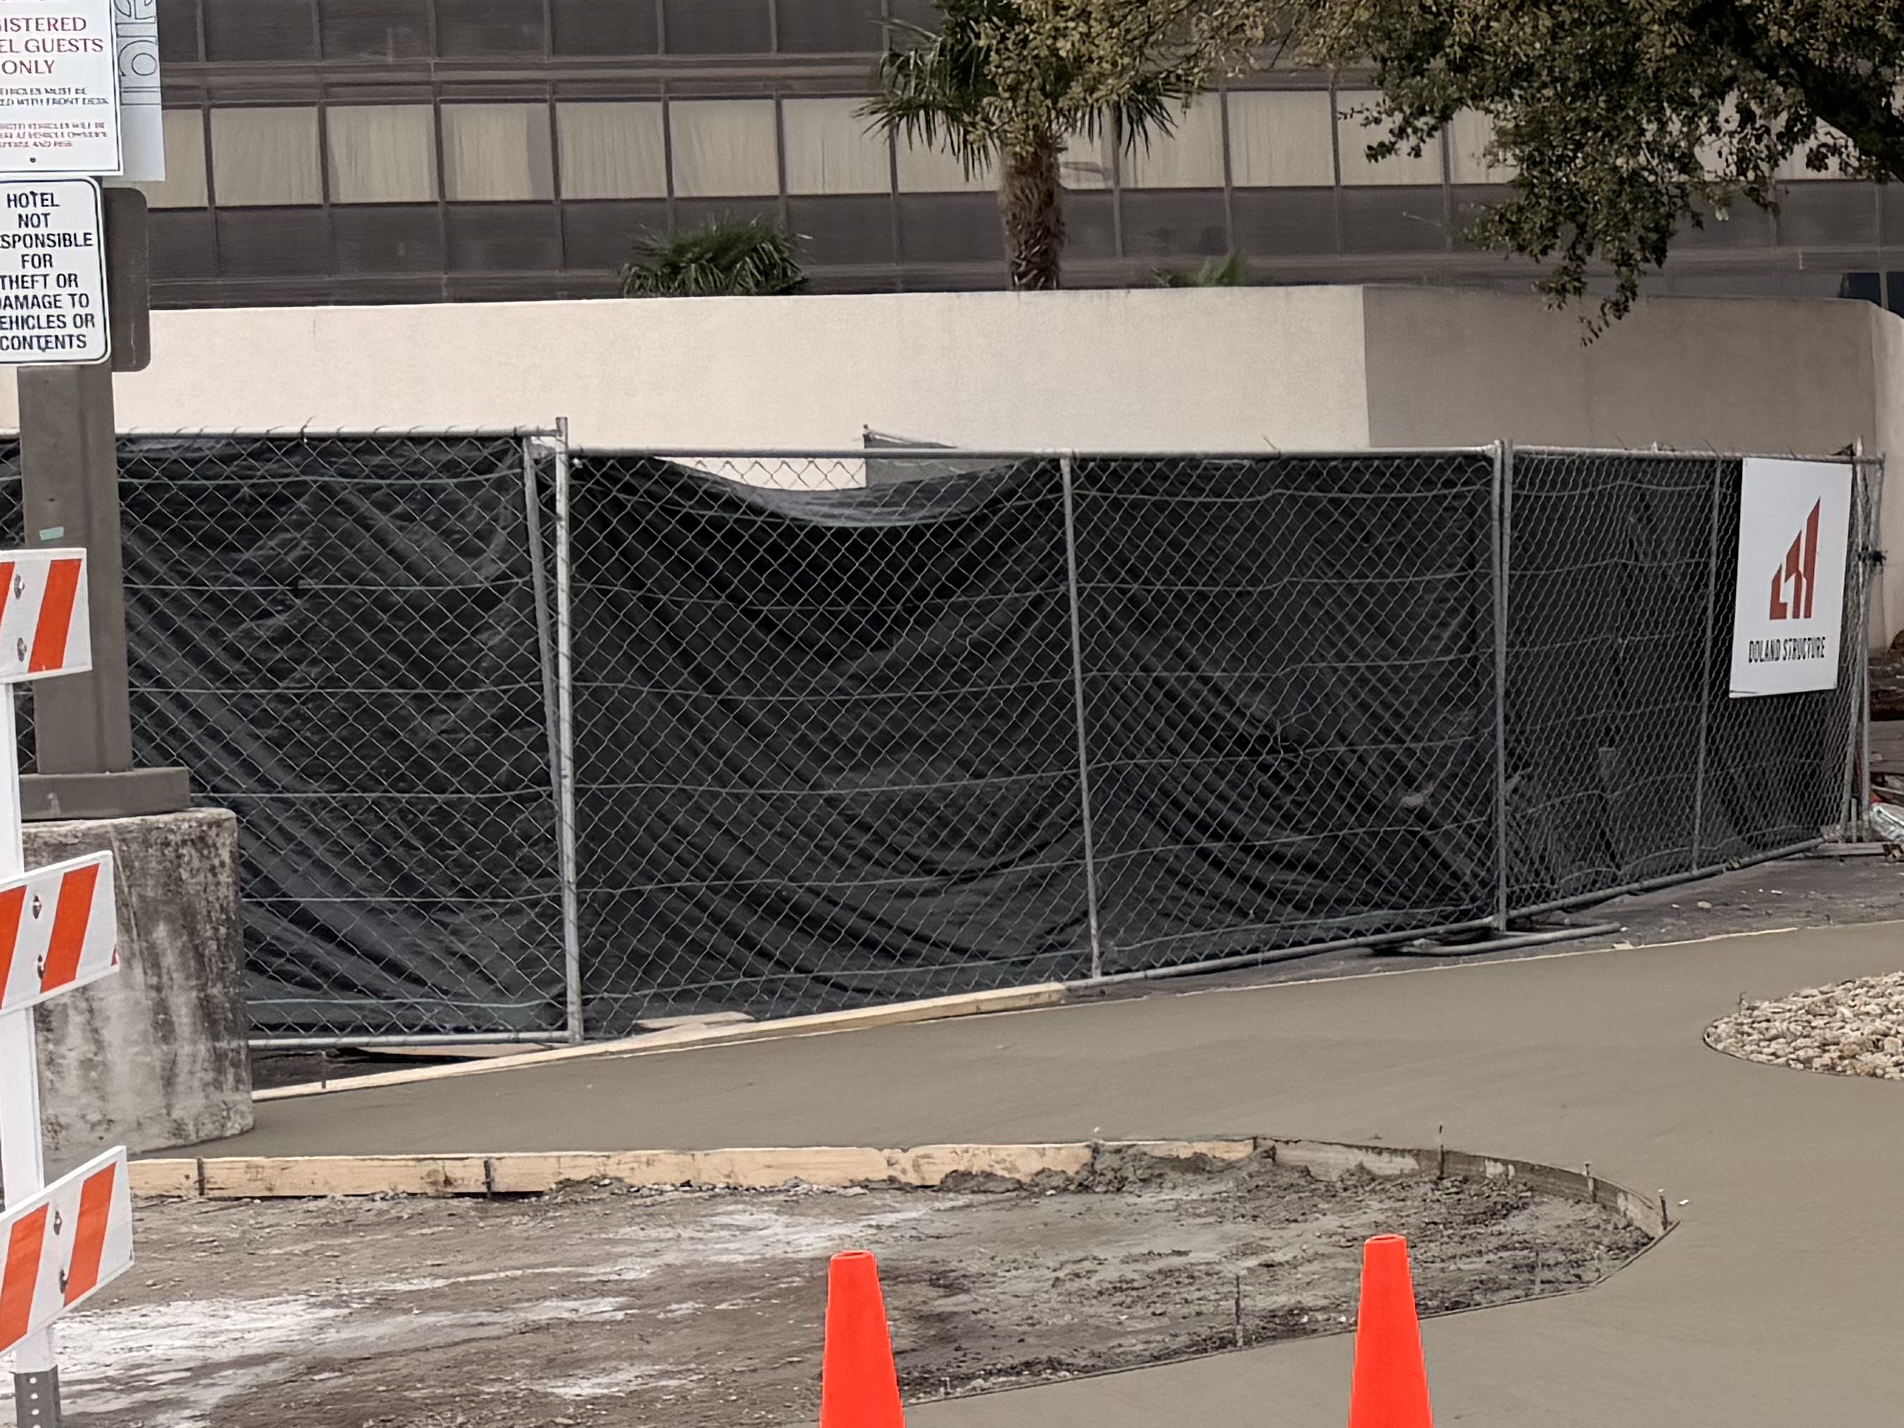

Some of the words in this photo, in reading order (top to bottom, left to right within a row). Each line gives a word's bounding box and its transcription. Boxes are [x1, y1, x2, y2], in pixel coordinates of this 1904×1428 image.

[0, 17, 87, 33] ISTERED
[24, 37, 104, 54] GUESTS
[1, 59, 55, 75] ONLY
[6, 190, 61, 208] HOTEL
[17, 212, 51, 229] NOT
[0, 232, 94, 250] SPONSIBLE
[21, 253, 54, 270] FOR
[0, 273, 50, 291] THEFT
[56, 272, 79, 289] OR
[0, 293, 63, 311] AMAGE
[67, 293, 90, 309] TO
[72, 313, 96, 329] OR
[0, 333, 87, 353] CONTENTS
[1749, 640, 1781, 663] DOLAND
